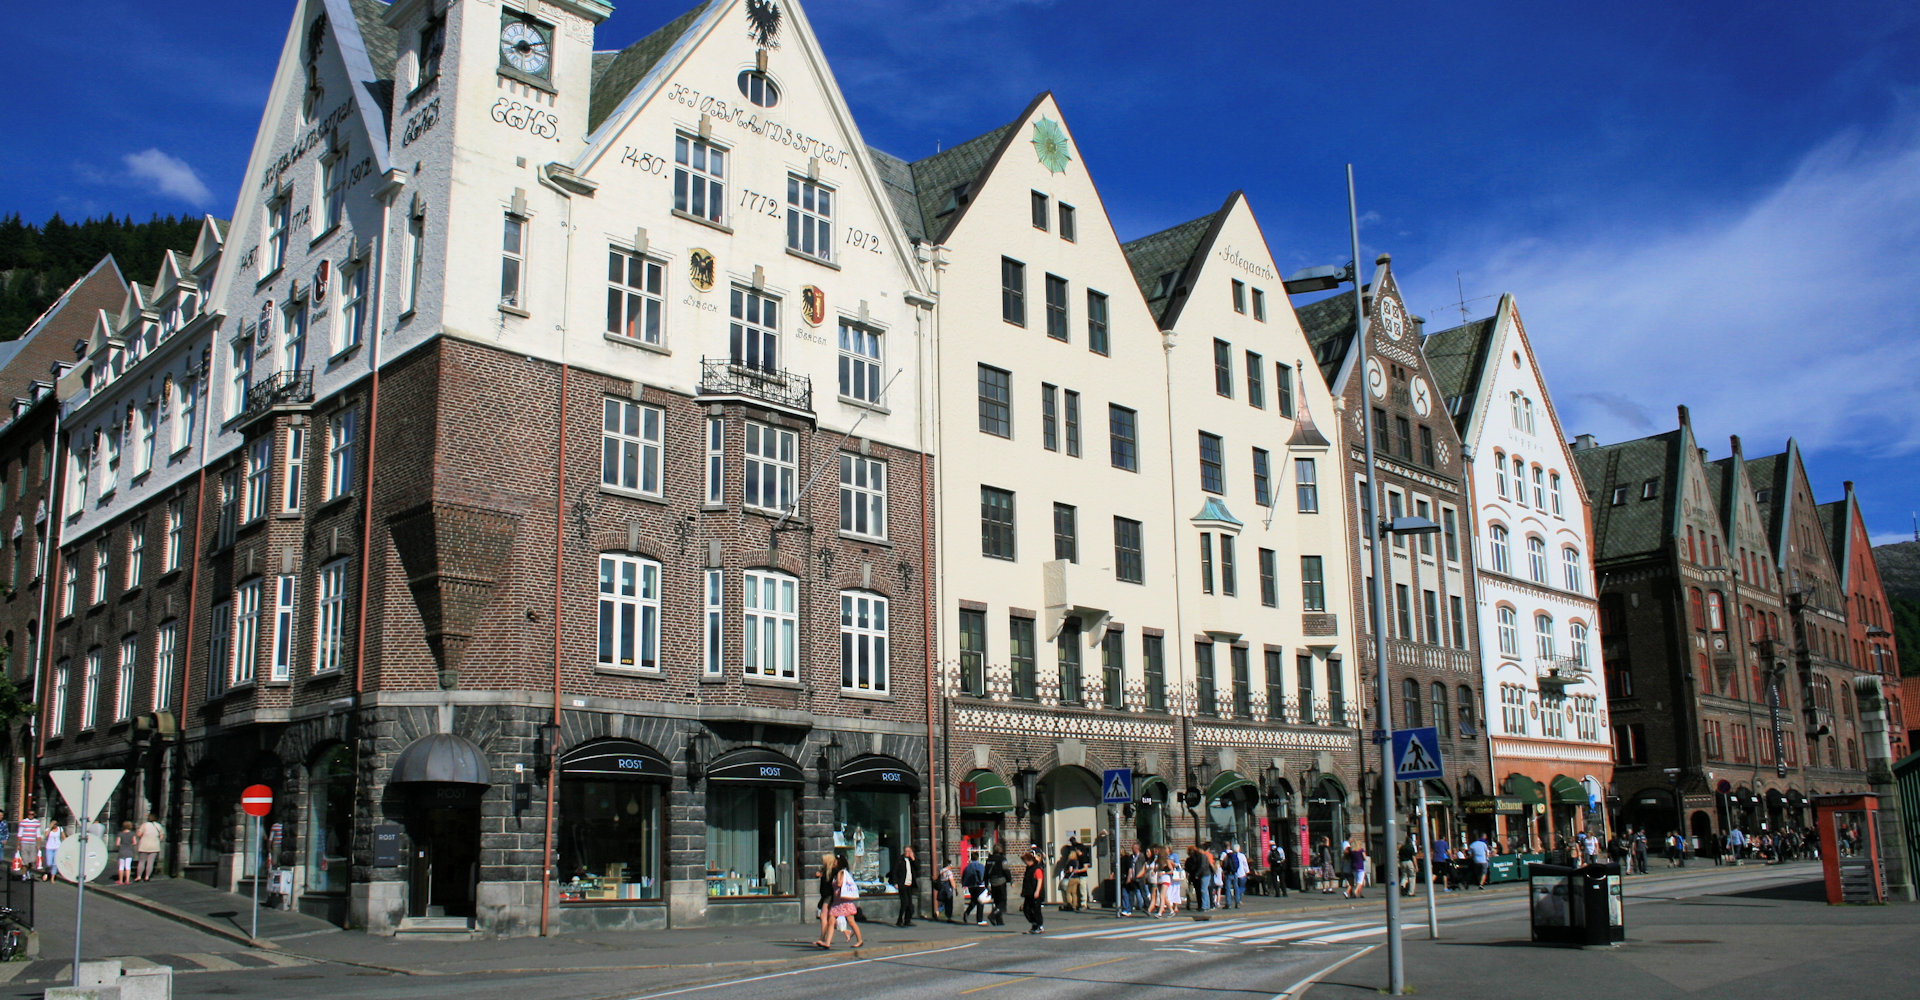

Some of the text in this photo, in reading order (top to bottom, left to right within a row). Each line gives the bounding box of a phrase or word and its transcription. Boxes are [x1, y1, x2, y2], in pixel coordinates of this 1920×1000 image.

[620, 145, 668, 179] 1480.
[739, 189, 782, 220] 1712.
[845, 227, 883, 255] 1912.
